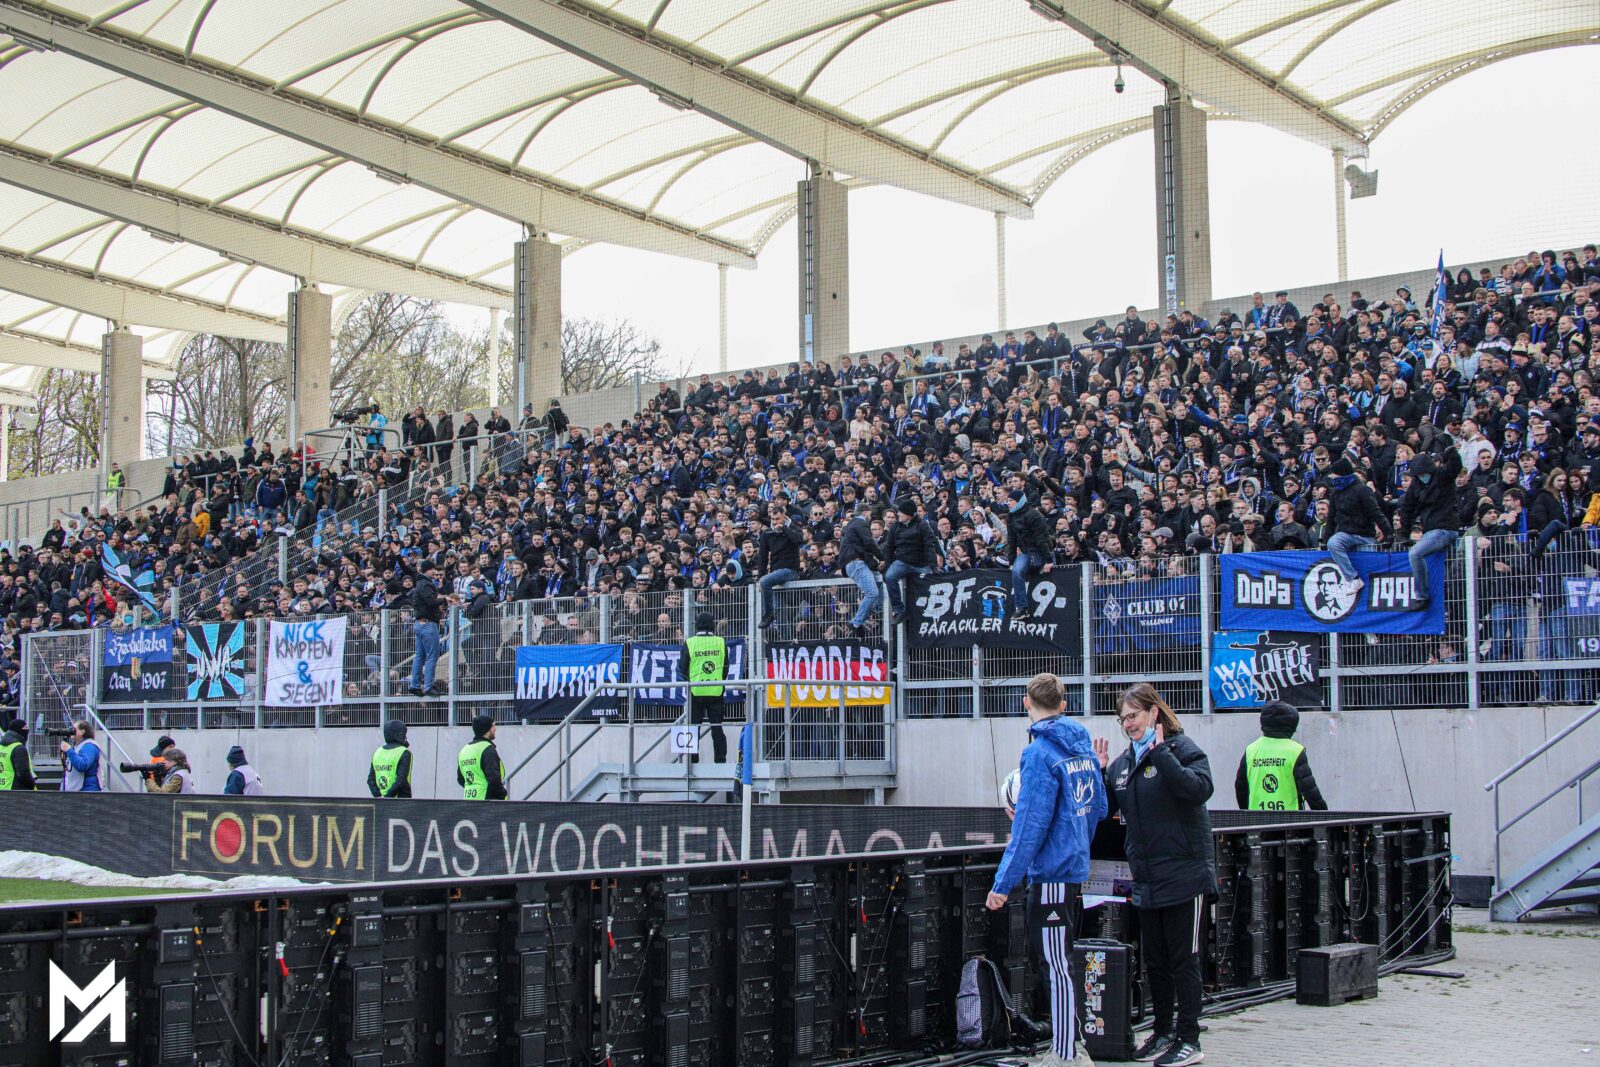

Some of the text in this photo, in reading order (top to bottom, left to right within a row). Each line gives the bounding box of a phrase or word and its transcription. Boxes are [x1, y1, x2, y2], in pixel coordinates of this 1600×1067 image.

[1237, 573, 1418, 607] DoPa 199
[1127, 599, 1165, 615] CLUB
[1169, 596, 1186, 612] 07
[919, 617, 1058, 640] BARACKLER FRONT
[297, 660, 313, 684] &
[771, 646, 884, 701] WOODLES
[1214, 644, 1313, 684] WALDHOF
[141, 670, 167, 690] 1907
[516, 662, 619, 700] KAPUTTICKS
[676, 731, 694, 748] C2
[1252, 757, 1286, 767] SICHERHEIT
[180, 811, 366, 870] FORUM
[387, 817, 480, 877] DAS
